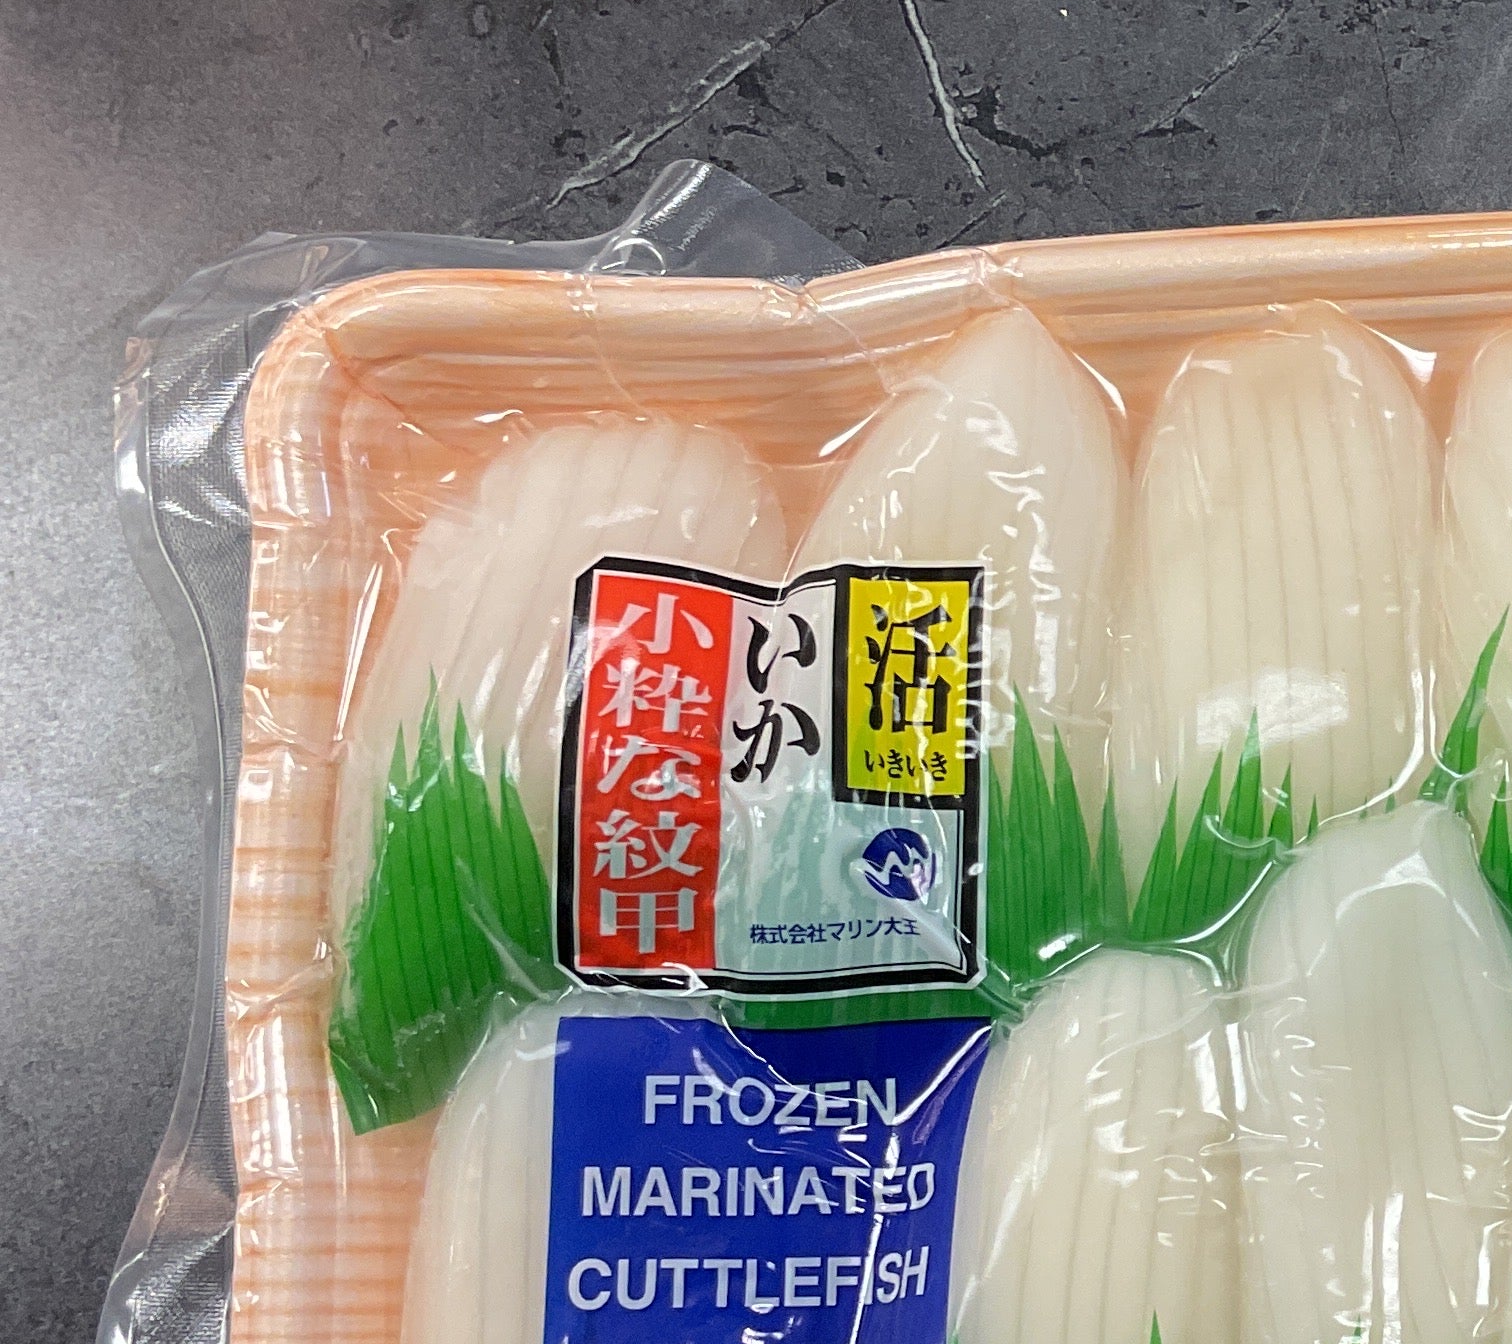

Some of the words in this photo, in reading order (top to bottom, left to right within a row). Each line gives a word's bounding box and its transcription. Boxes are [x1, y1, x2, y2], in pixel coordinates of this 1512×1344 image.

[864, 603, 955, 733] 活
[730, 613, 821, 783] いか
[593, 592, 714, 954] 小粋な紋甲
[864, 749, 948, 781] いきいき
[750, 918, 920, 945] 株式会社マリン大王
[644, 1075, 897, 1126] FROZEN
[582, 1163, 935, 1216] MARINATED
[568, 1246, 929, 1311] CUTTLEFISH
